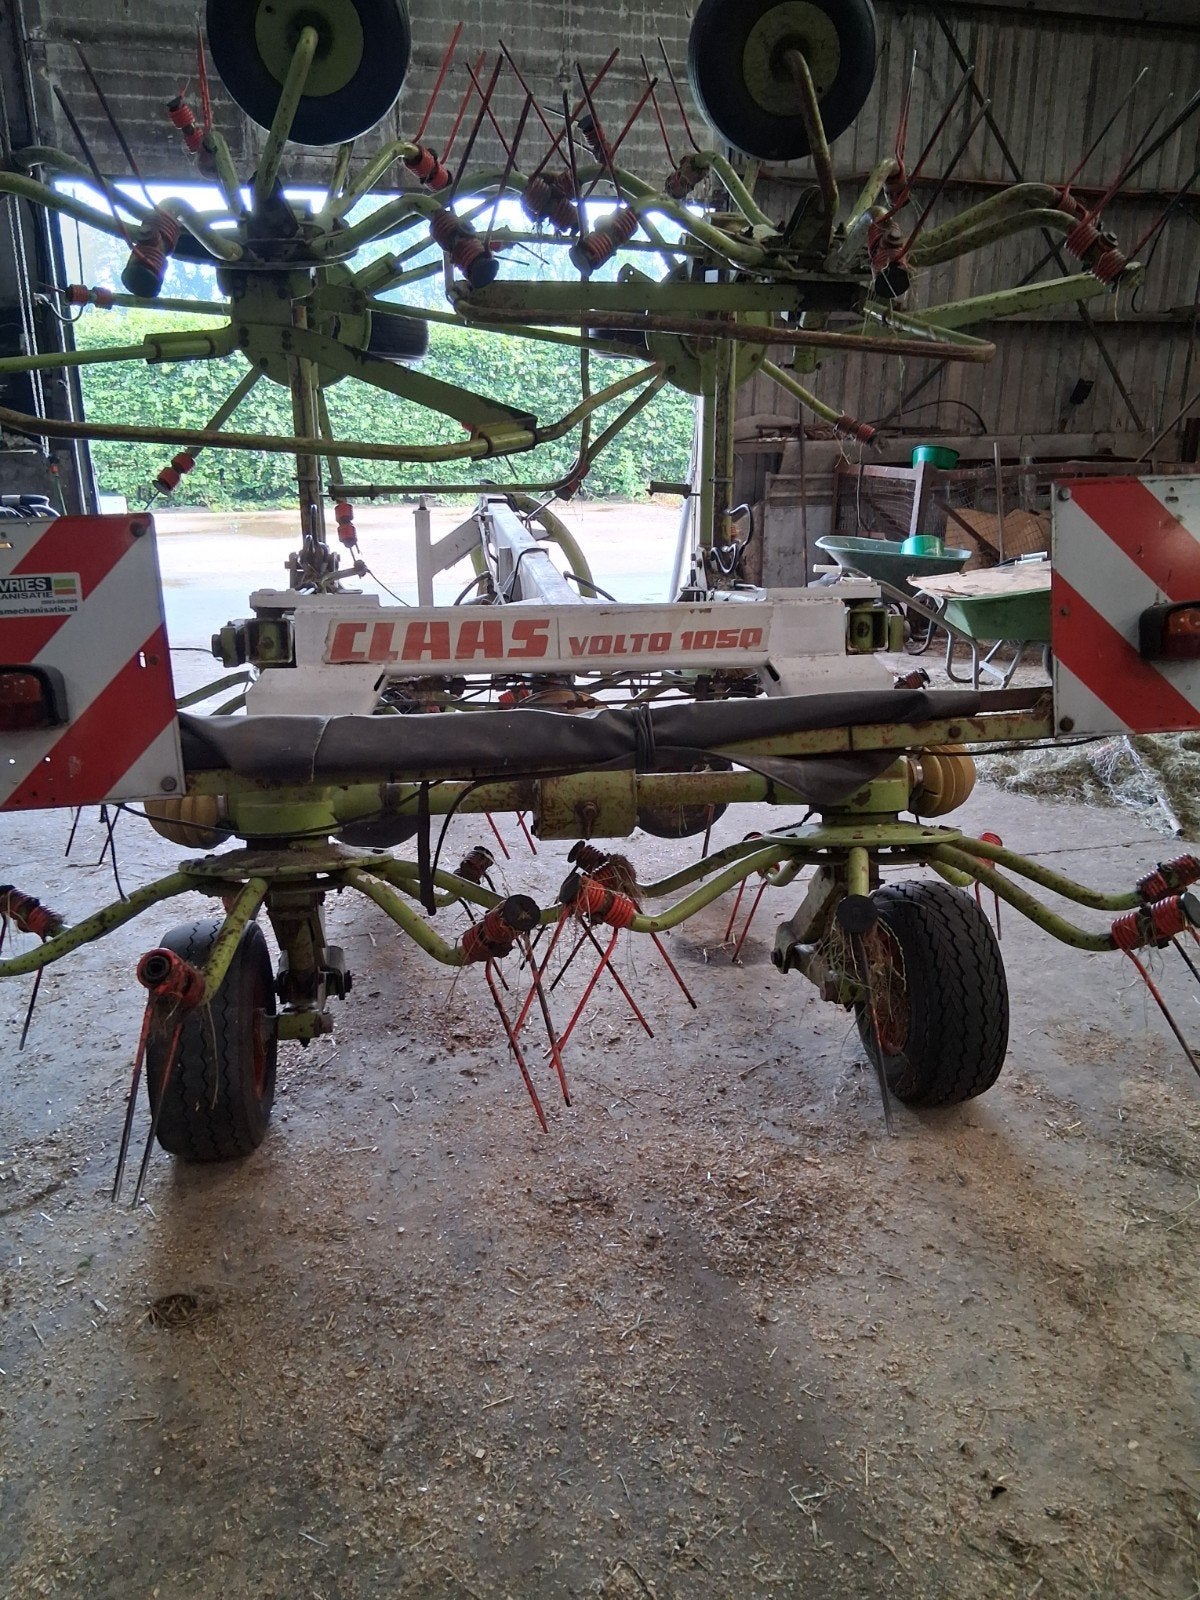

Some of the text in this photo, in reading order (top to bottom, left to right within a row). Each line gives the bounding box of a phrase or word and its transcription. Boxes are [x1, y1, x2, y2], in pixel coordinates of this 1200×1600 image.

[0, 578, 47, 592] VRIES
[330, 619, 550, 661] CLAAS
[568, 627, 763, 656] VOLTO 1050
